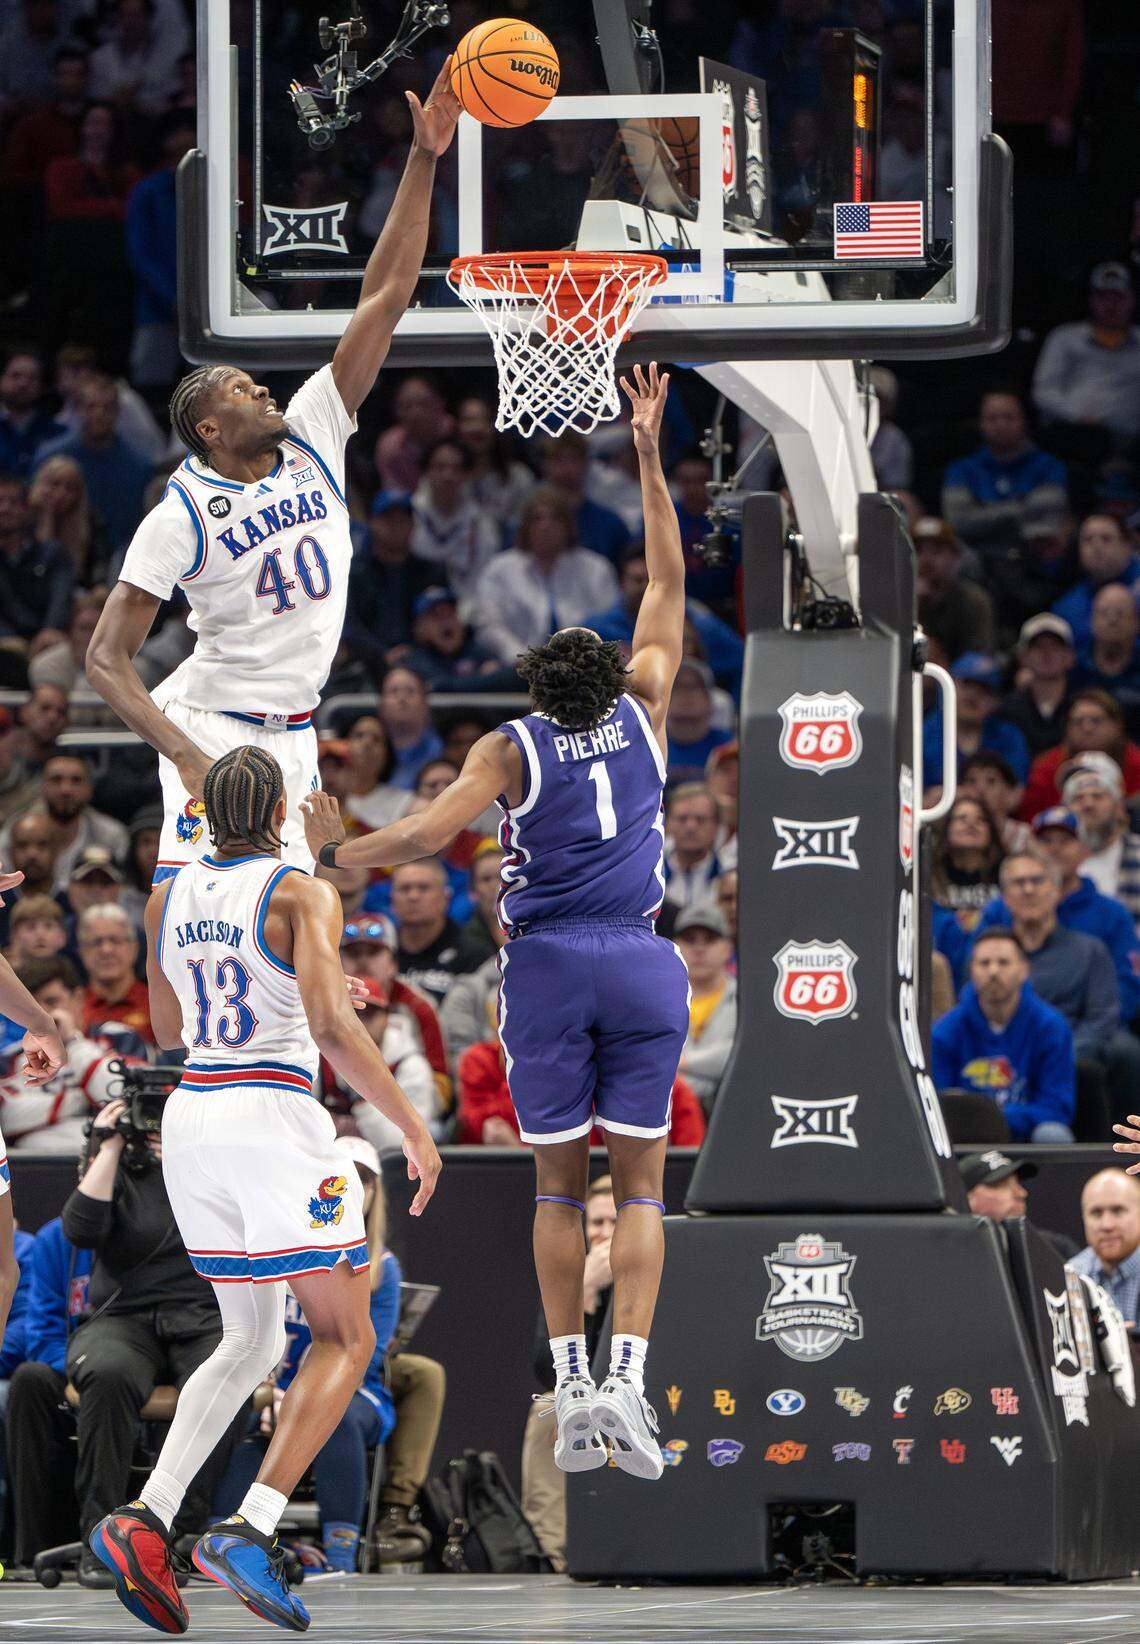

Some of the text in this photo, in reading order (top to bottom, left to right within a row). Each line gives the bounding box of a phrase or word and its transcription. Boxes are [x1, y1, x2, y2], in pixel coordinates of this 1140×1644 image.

[262, 201, 349, 256] XII
[209, 498, 230, 516] SW
[216, 490, 328, 561] KANSAS
[256, 535, 332, 615] 40
[792, 705, 849, 718] PHILLIPS
[553, 720, 631, 762] PIERRE
[795, 724, 845, 756] 66
[587, 760, 617, 840] 1
[772, 816, 860, 870] XII
[787, 954, 844, 968] PHILLIPS
[187, 956, 259, 1048] 13
[789, 974, 839, 1006] 66
[770, 1094, 859, 1149] XII
[319, 1203, 333, 1214] KU
[769, 1262, 849, 1306] XII
[762, 1316, 857, 1333] TOURNAMENT
[765, 1307, 855, 1324] BASKETBALL
[713, 1388, 736, 1416] BU
